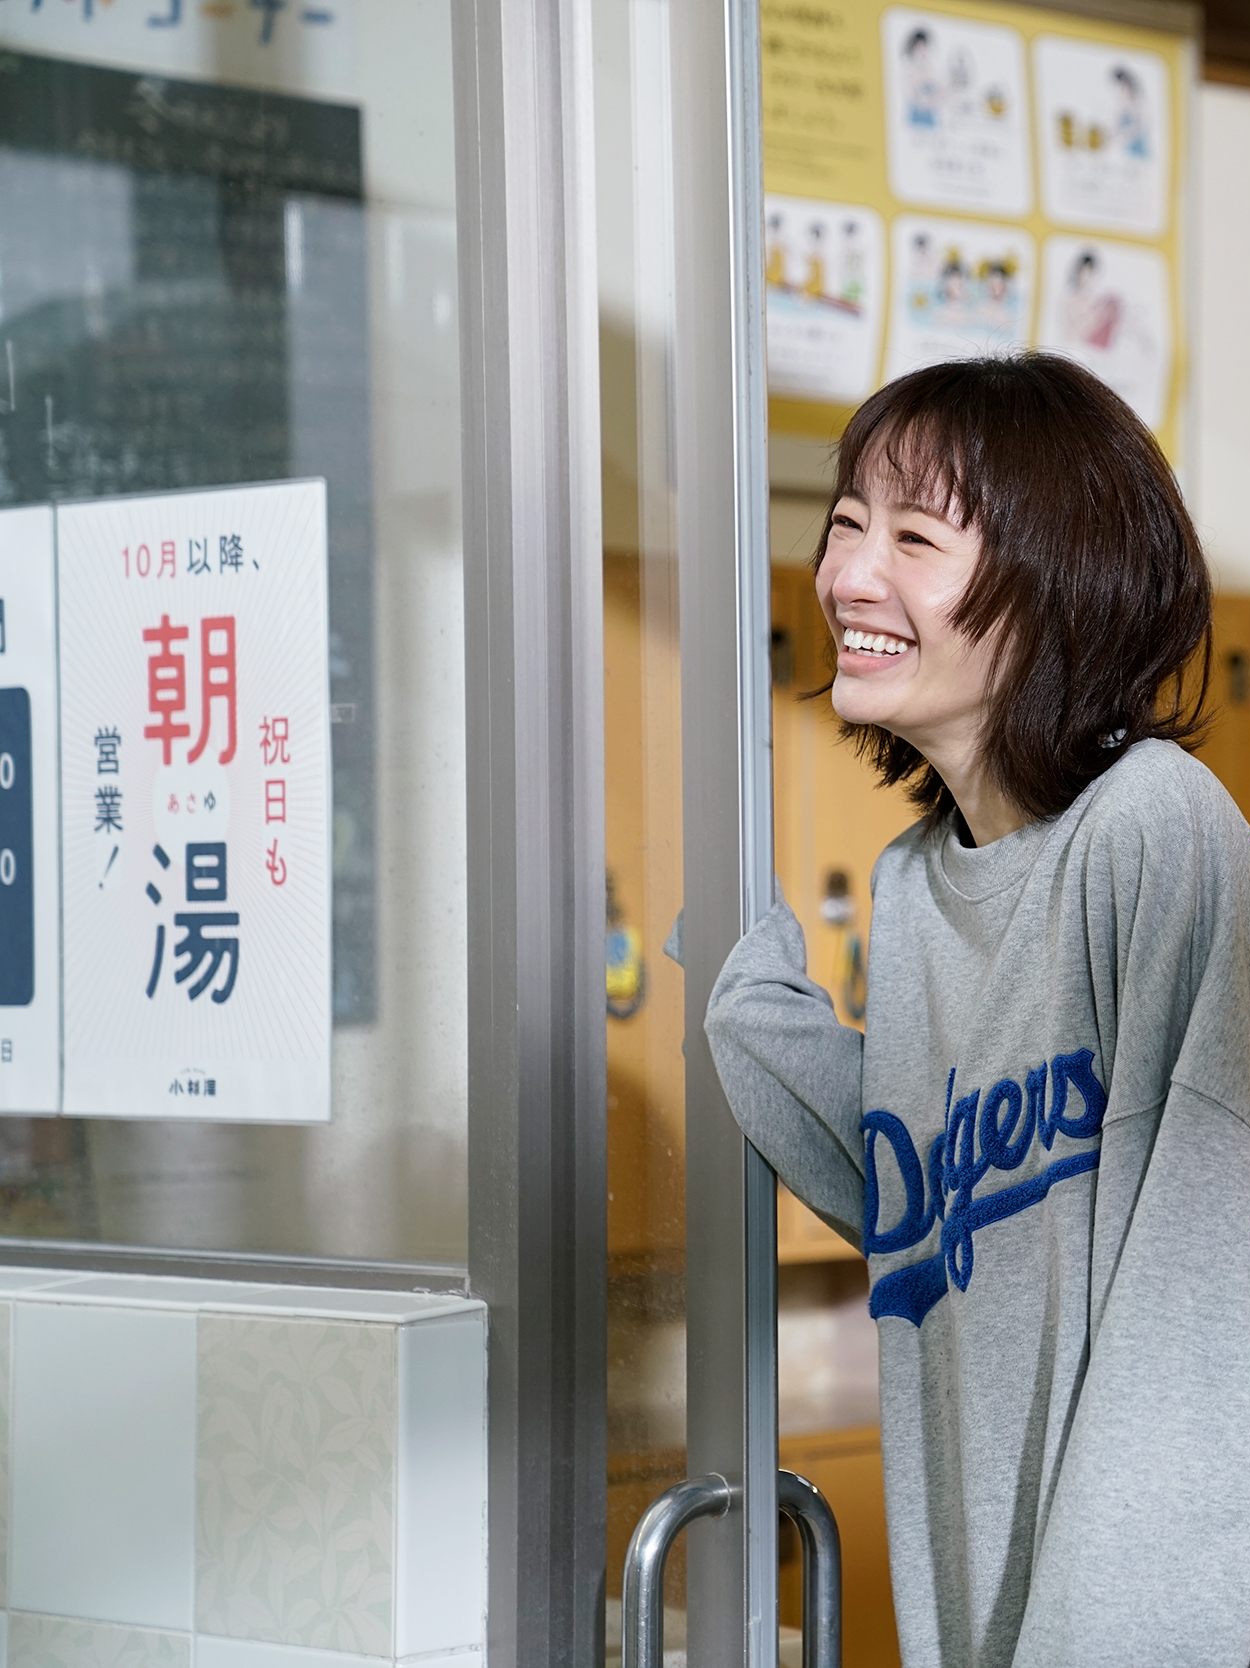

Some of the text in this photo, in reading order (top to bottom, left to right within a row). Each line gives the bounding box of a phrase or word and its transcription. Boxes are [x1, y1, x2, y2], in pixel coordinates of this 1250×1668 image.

[121, 533, 260, 580] 10月以降、
[167, 790, 217, 815] あさゆ
[259, 715, 292, 887] 祝日も
[859, 1047, 1108, 1293] Dogers
